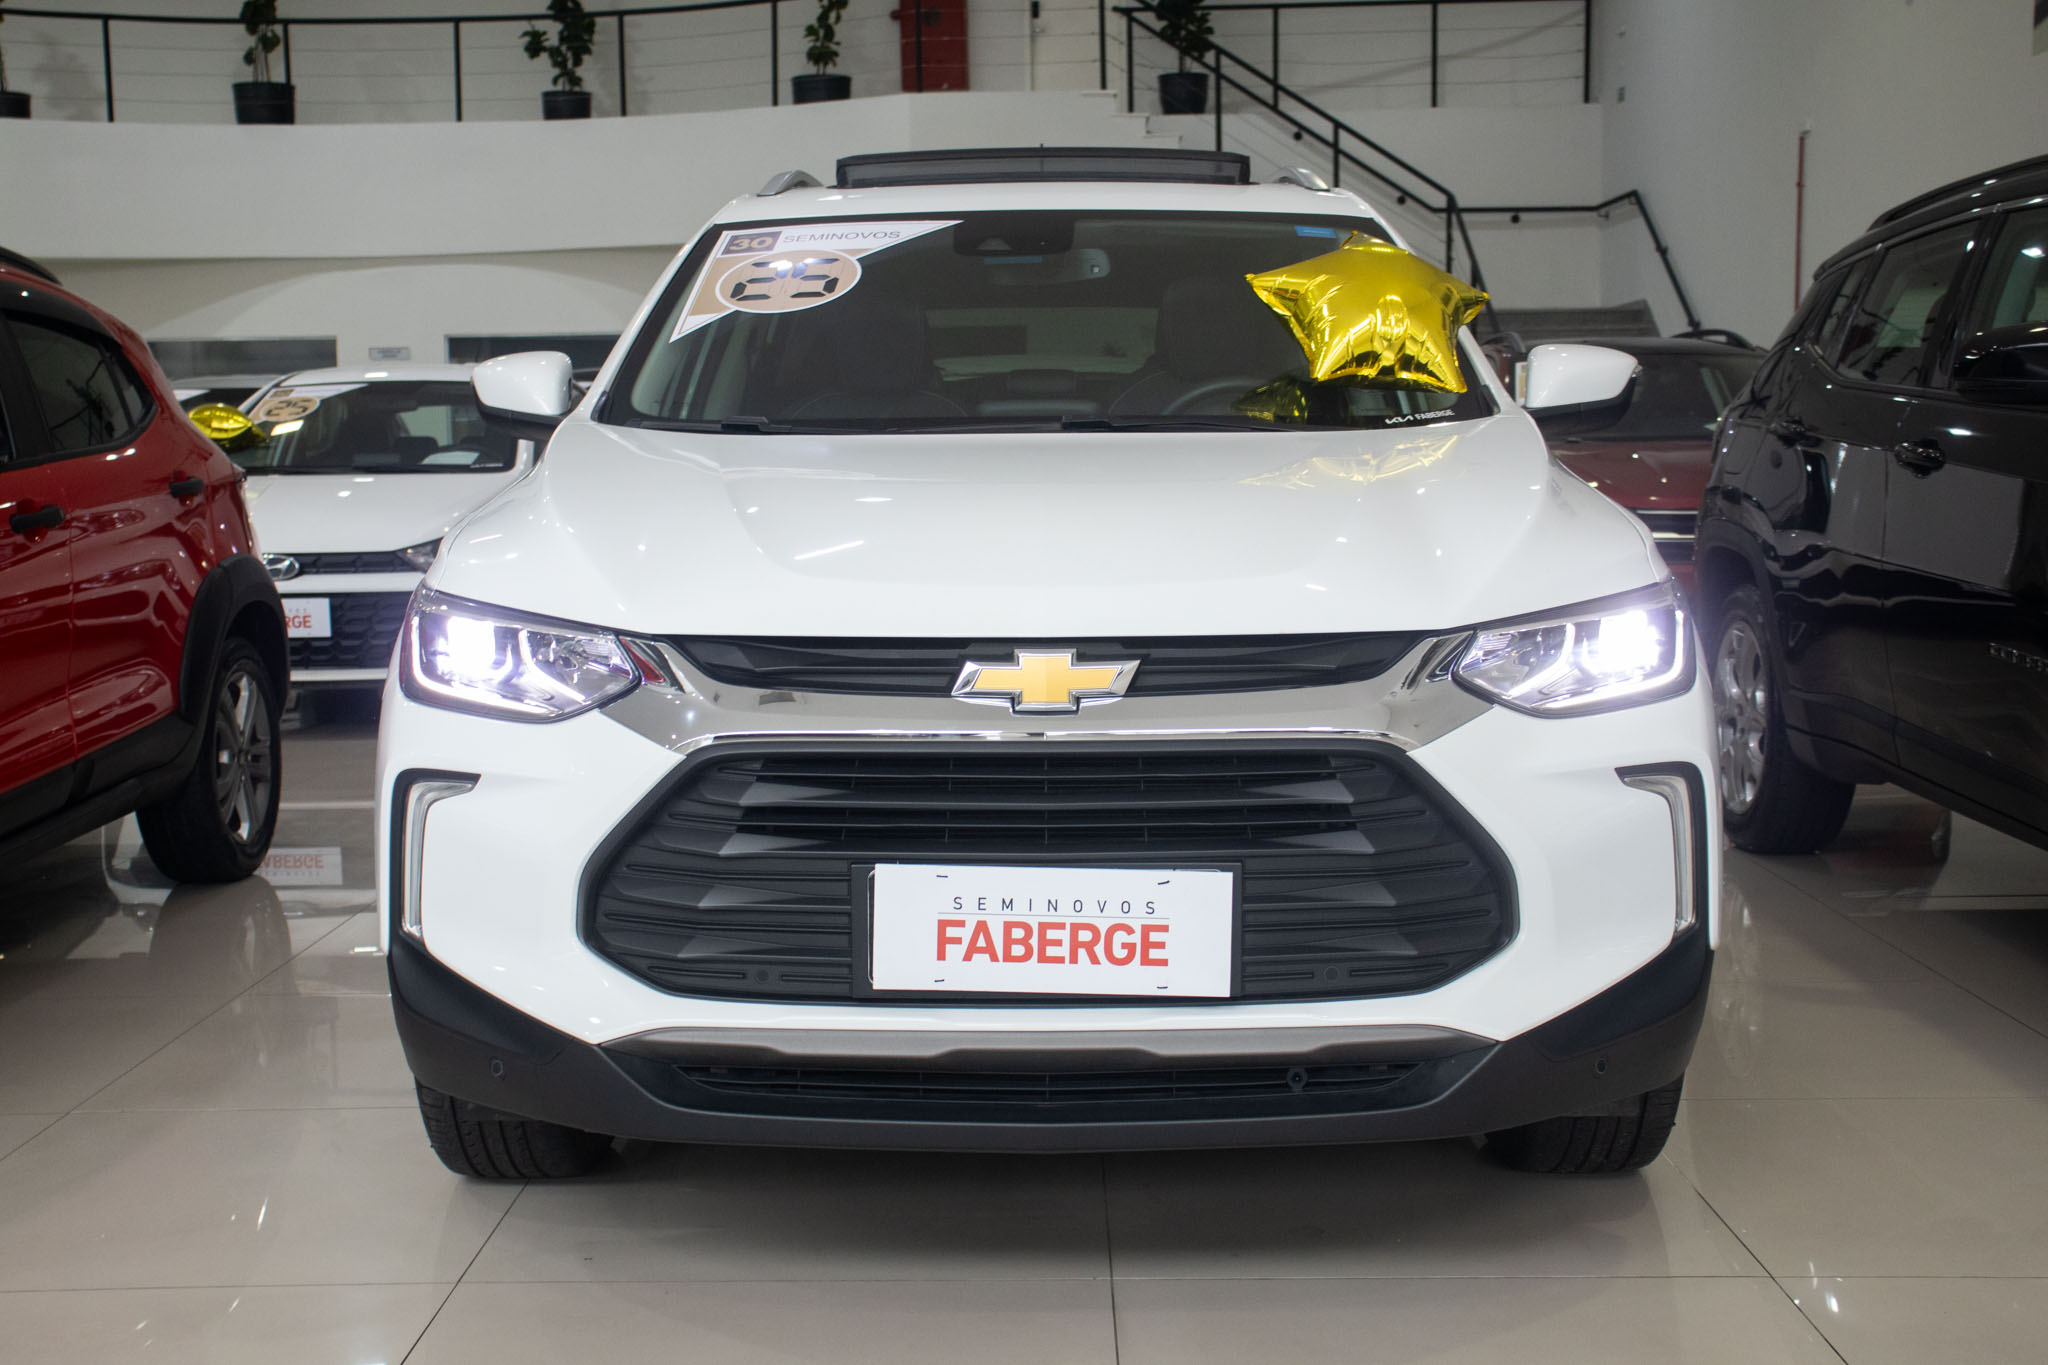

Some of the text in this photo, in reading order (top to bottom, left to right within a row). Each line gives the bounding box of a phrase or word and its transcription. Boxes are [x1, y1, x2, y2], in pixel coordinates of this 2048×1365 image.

[731, 231, 901, 250] 30 SEMINOVOS
[730, 258, 840, 301] 25
[284, 615, 312, 628] RGE
[953, 897, 1155, 914] SEMINOVOS
[936, 919, 1170, 967] FABERGE
